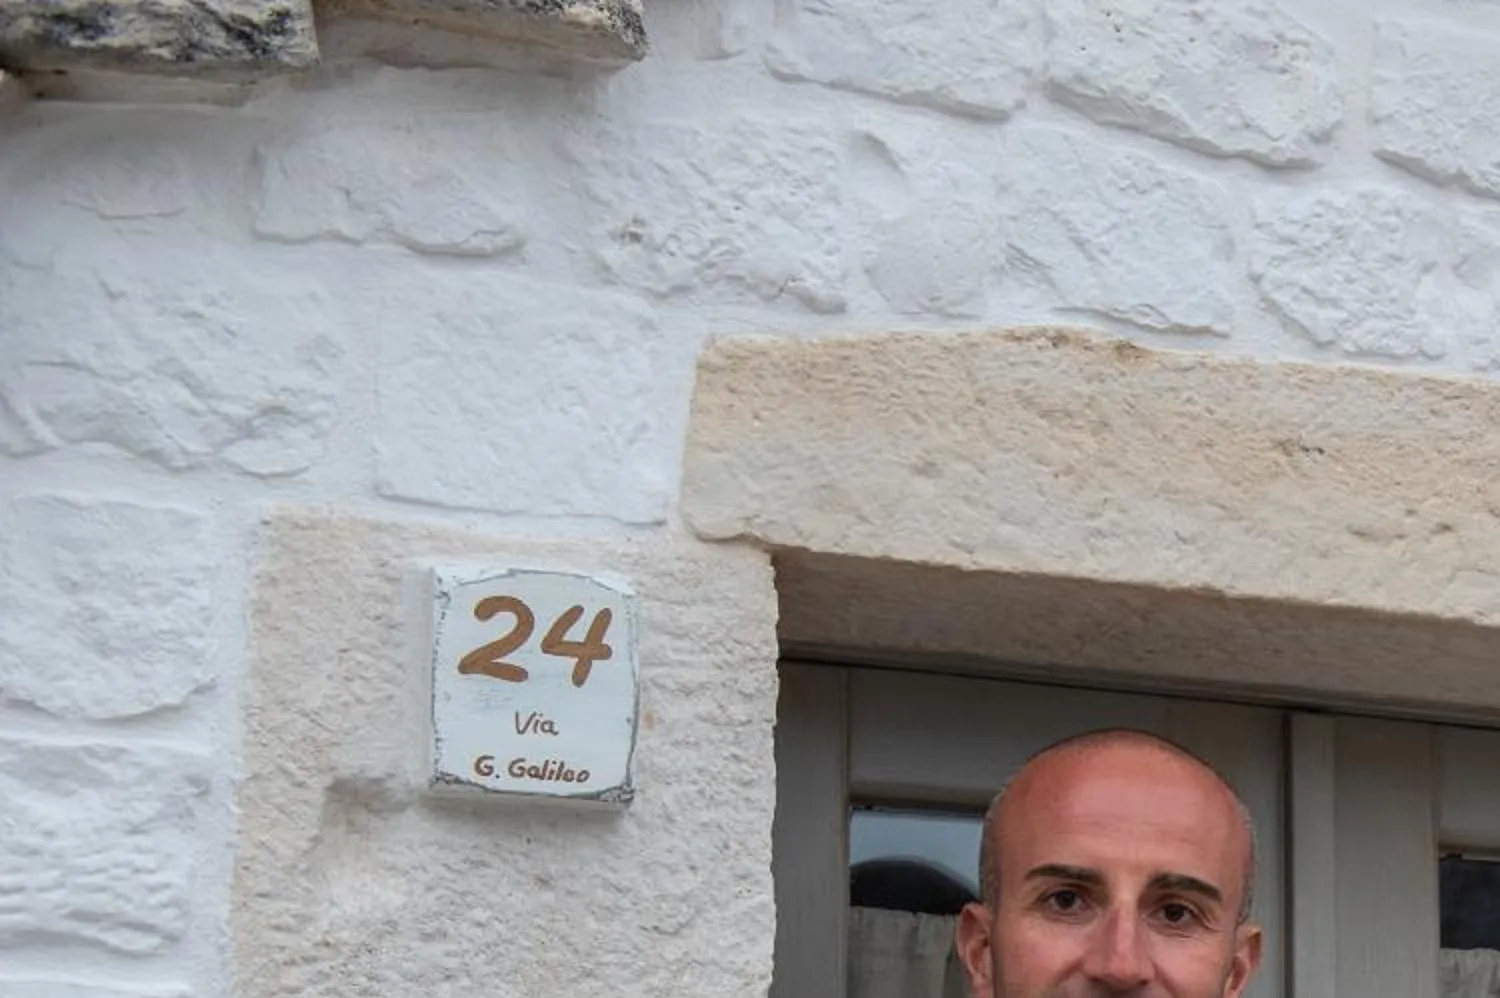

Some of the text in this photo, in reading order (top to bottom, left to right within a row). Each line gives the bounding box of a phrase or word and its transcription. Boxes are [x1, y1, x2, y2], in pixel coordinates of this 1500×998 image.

[458, 596, 613, 688] 24
[515, 711, 559, 736] Via
[474, 755, 590, 784] G. Galileo
